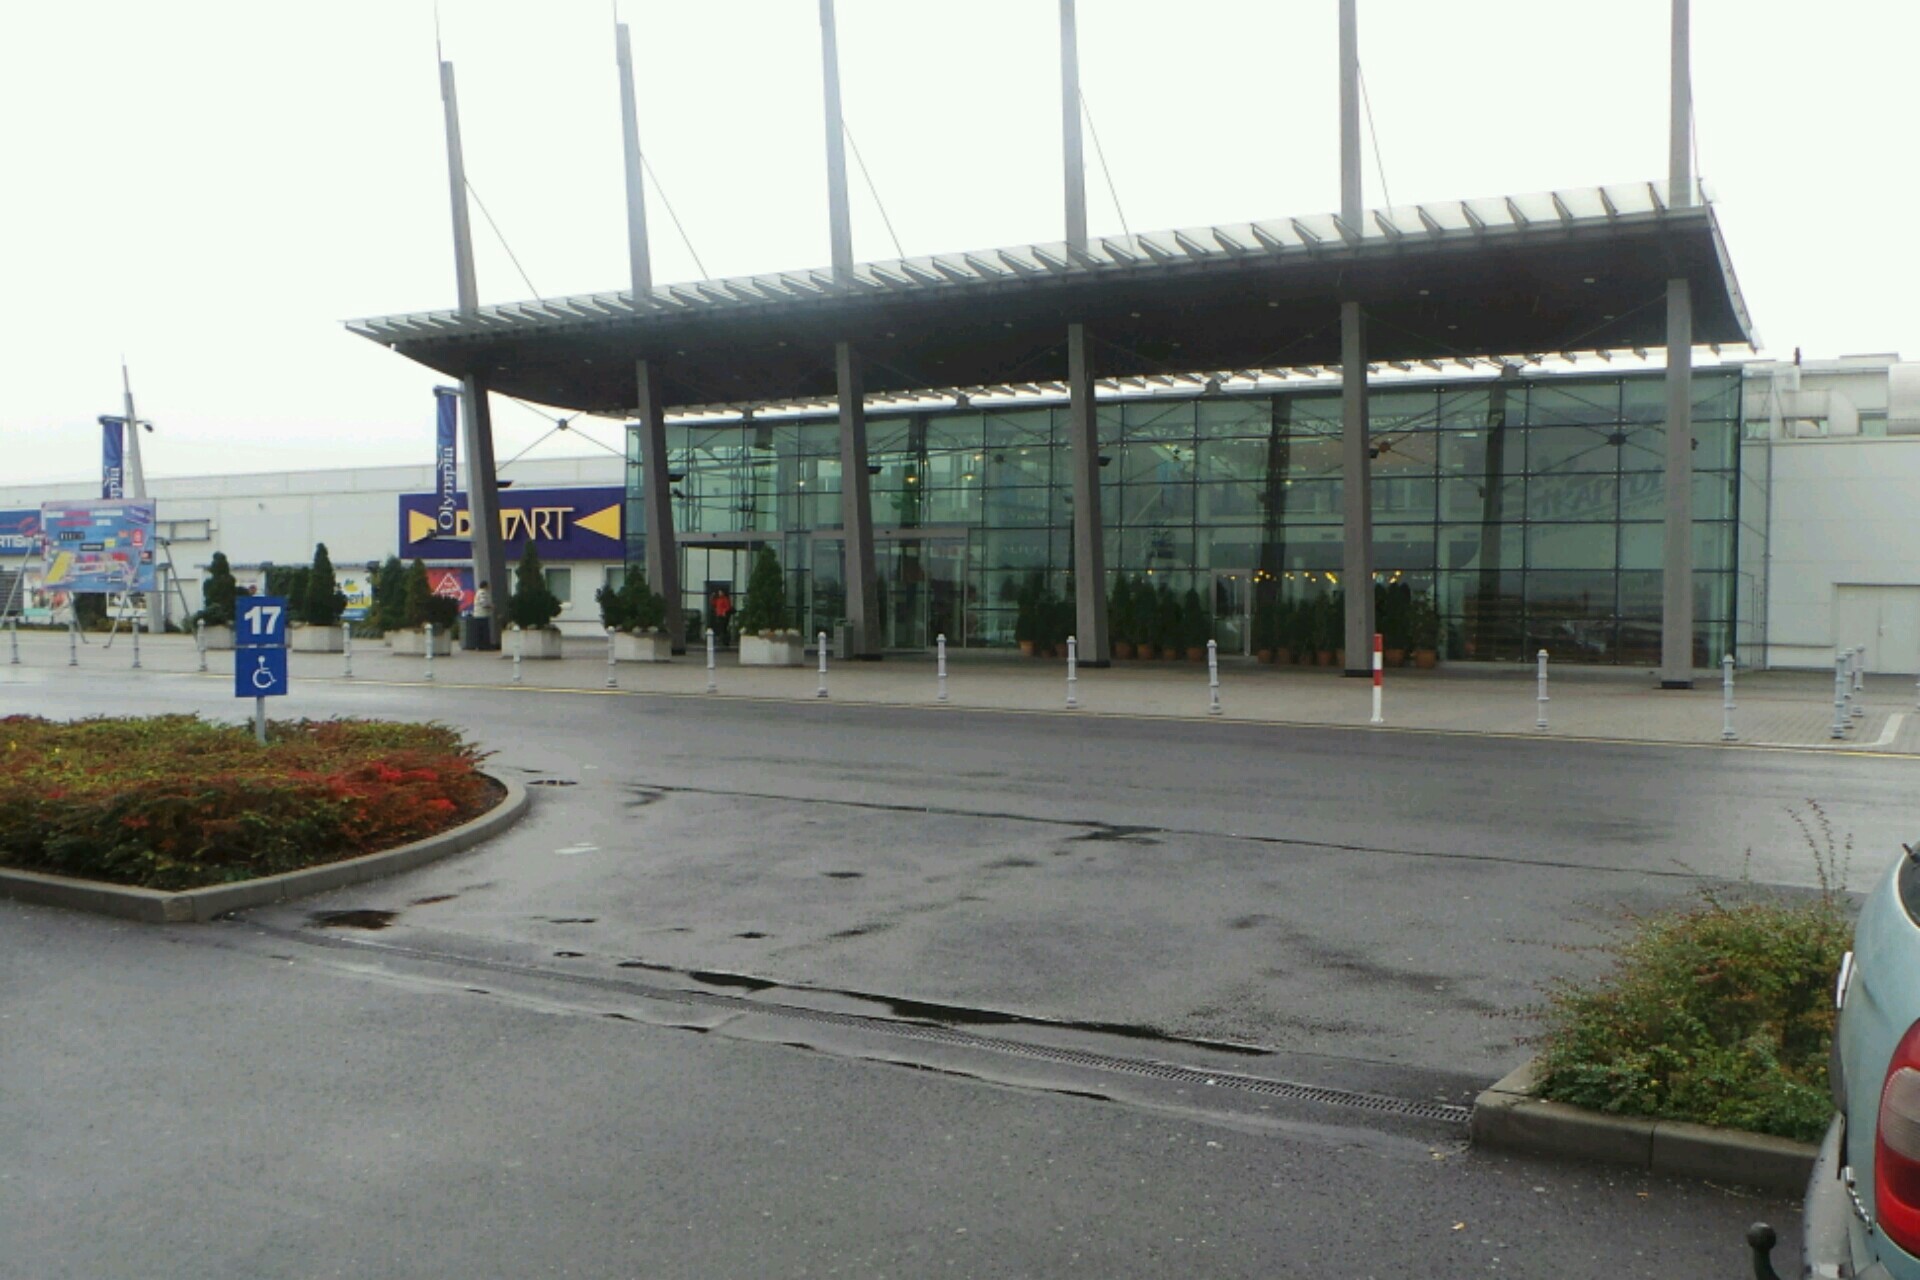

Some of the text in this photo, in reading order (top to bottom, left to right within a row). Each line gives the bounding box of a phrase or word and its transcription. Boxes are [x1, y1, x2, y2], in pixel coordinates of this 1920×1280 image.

[438, 447, 456, 530] Olympia
[456, 507, 574, 540] DTART
[244, 606, 281, 635] 17
